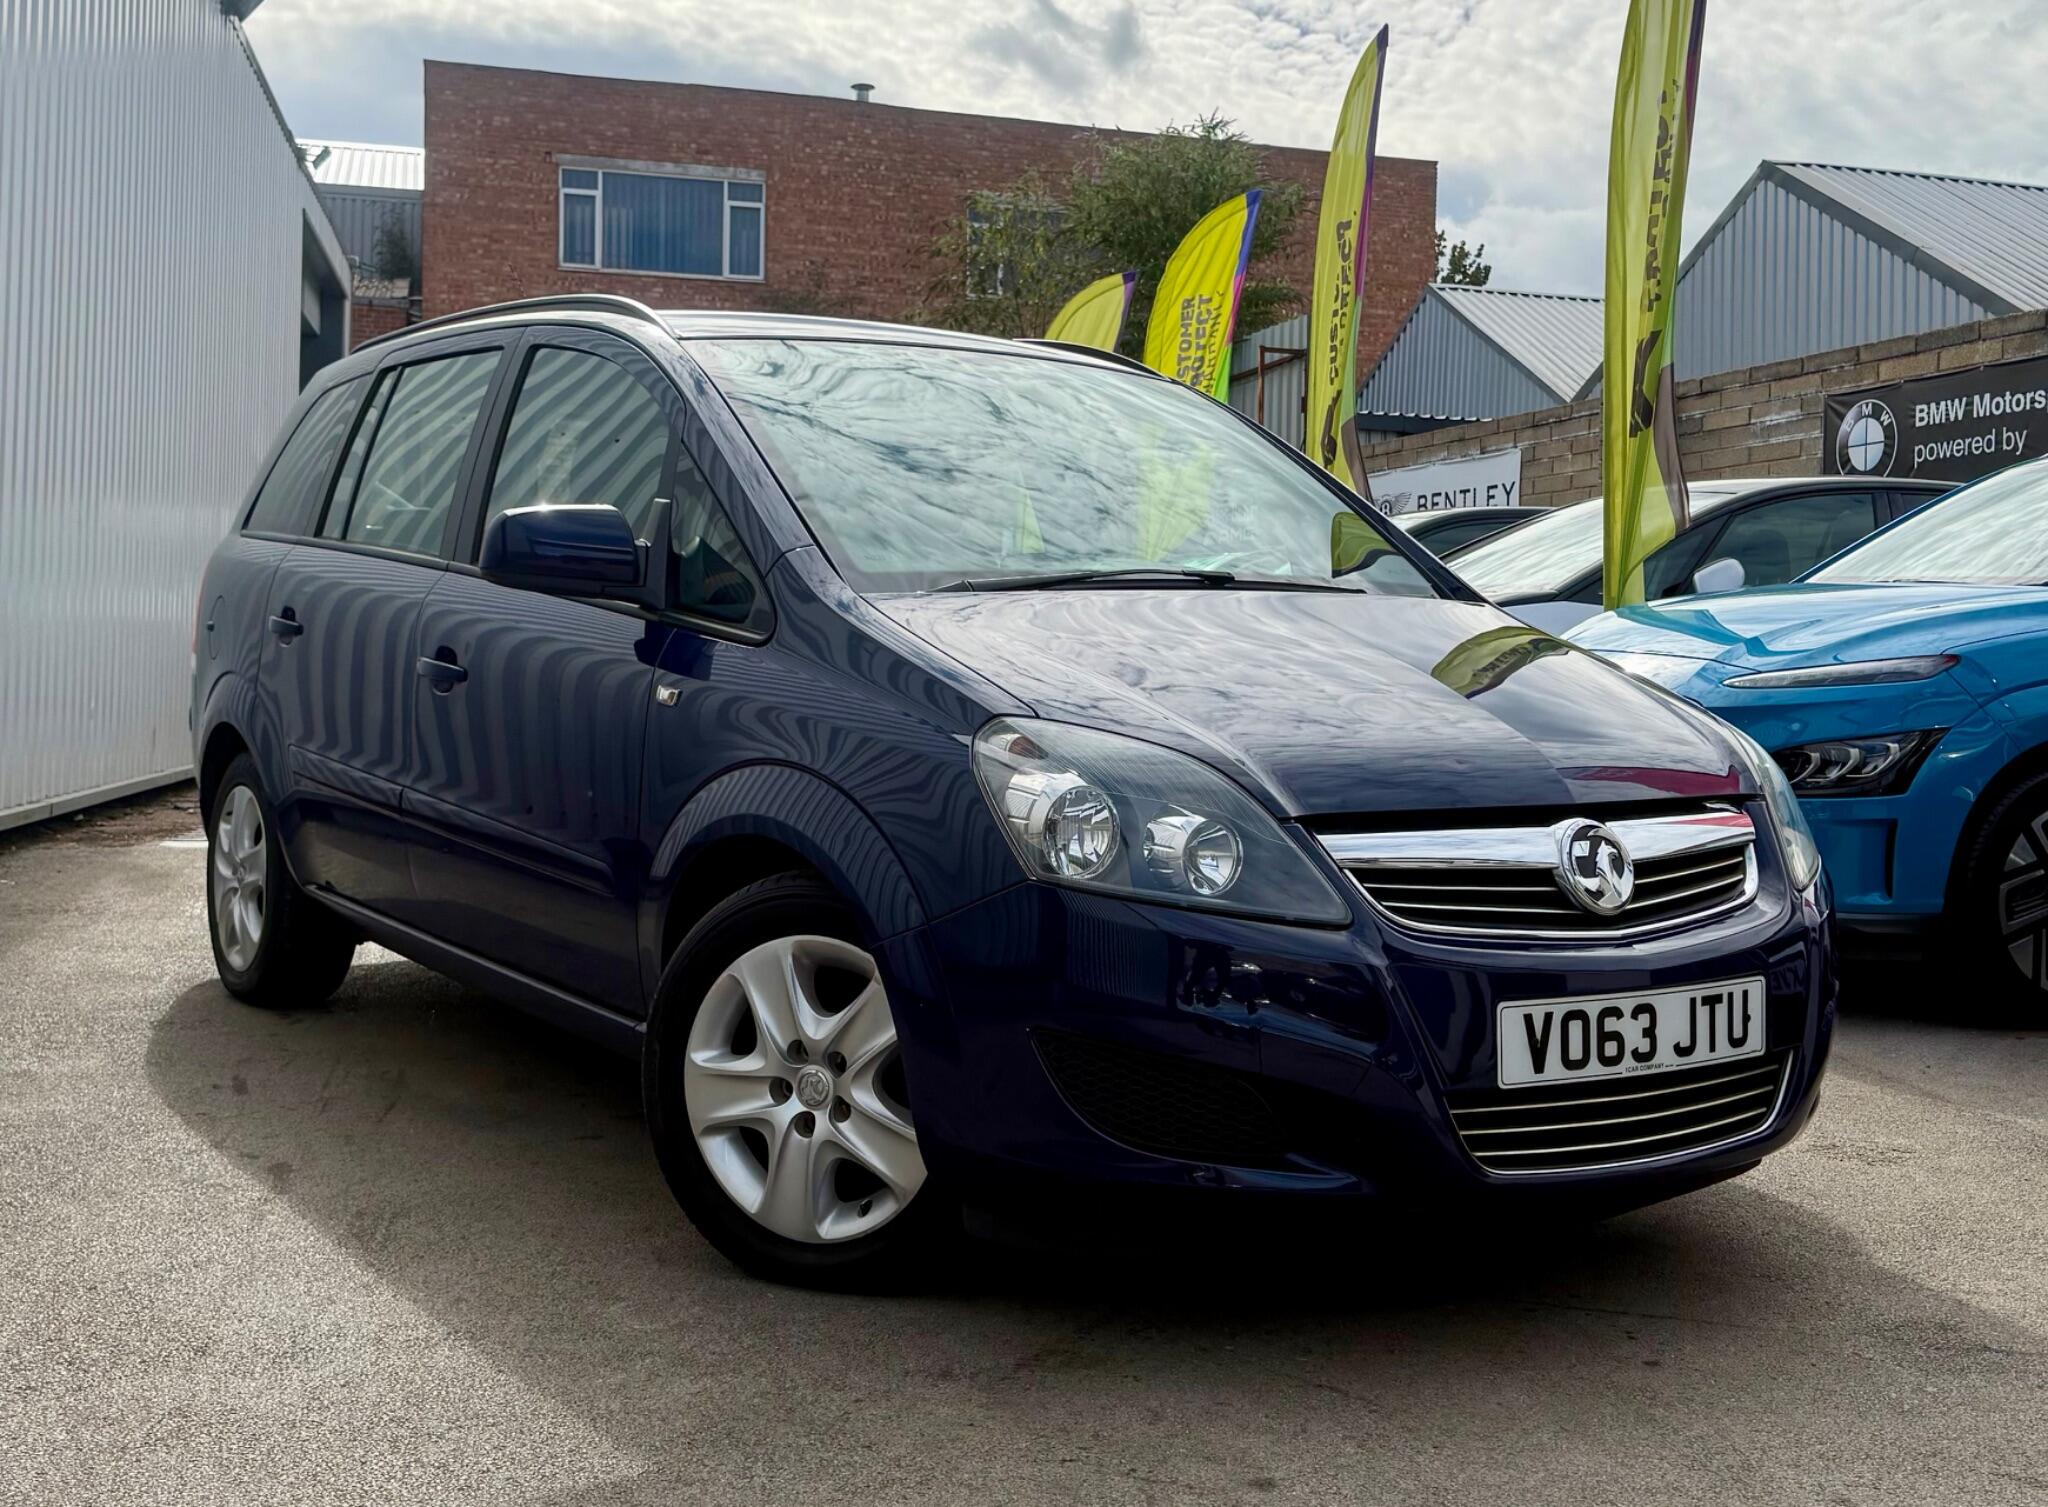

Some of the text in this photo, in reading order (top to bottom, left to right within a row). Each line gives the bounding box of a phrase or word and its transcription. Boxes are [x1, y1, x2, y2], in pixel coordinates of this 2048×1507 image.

[1176, 297, 1195, 384] STOMER
[1915, 389, 2048, 427] BMW Motors
[1914, 426, 2028, 468] powered by
[1523, 988, 1751, 1075] VO63 JTU
